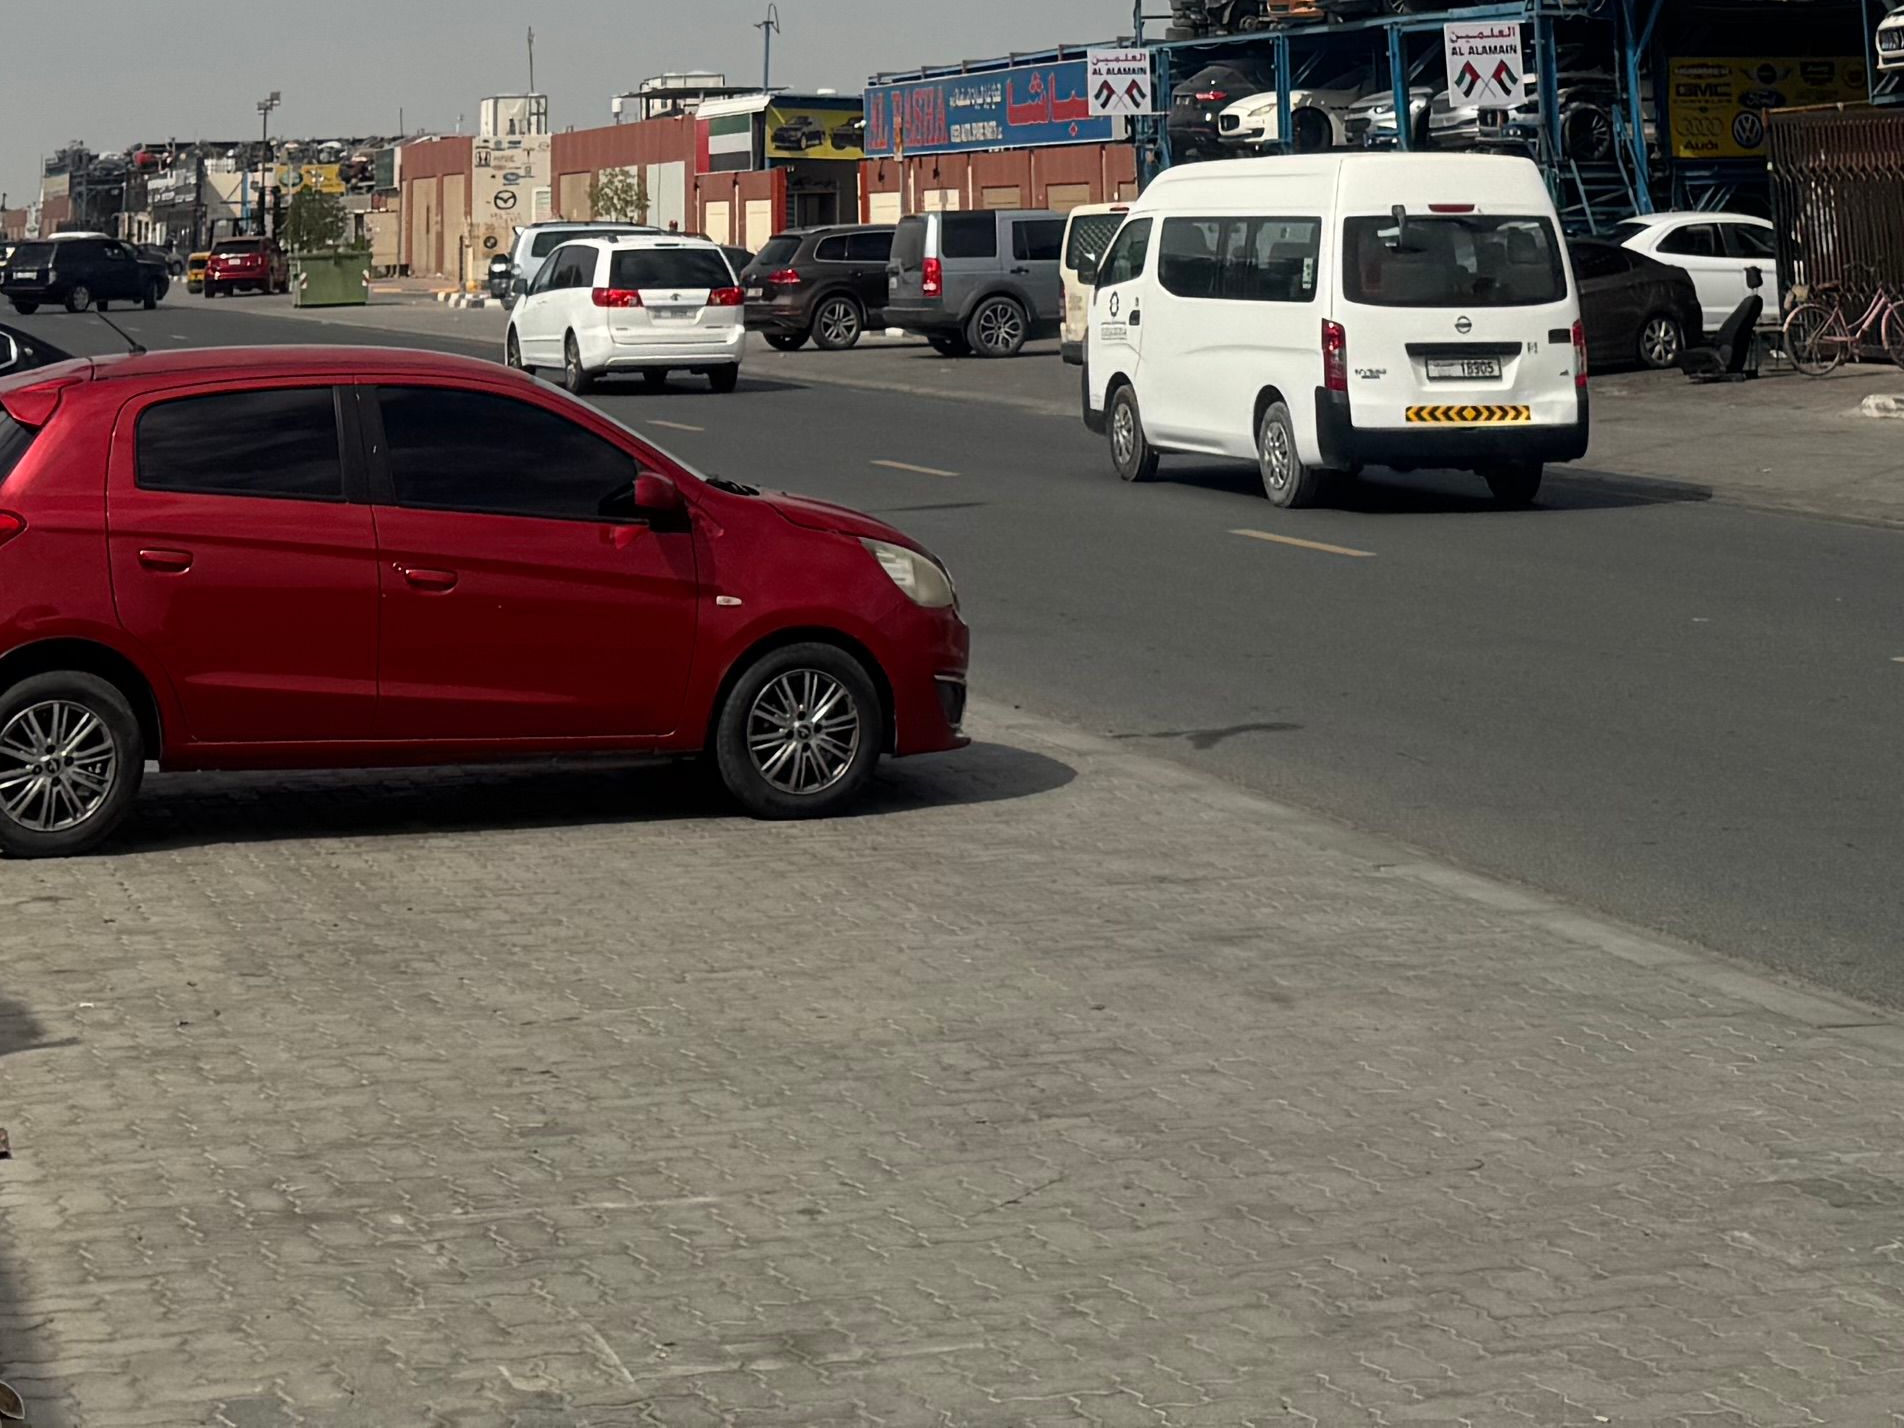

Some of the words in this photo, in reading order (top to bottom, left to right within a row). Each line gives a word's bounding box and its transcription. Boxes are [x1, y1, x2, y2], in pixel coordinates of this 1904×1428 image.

[1451, 46, 1465, 56] AL
[1468, 44, 1517, 55] ALAMAIN
[1092, 67, 1103, 75] AL
[1106, 67, 1147, 75] ALAMAIN
